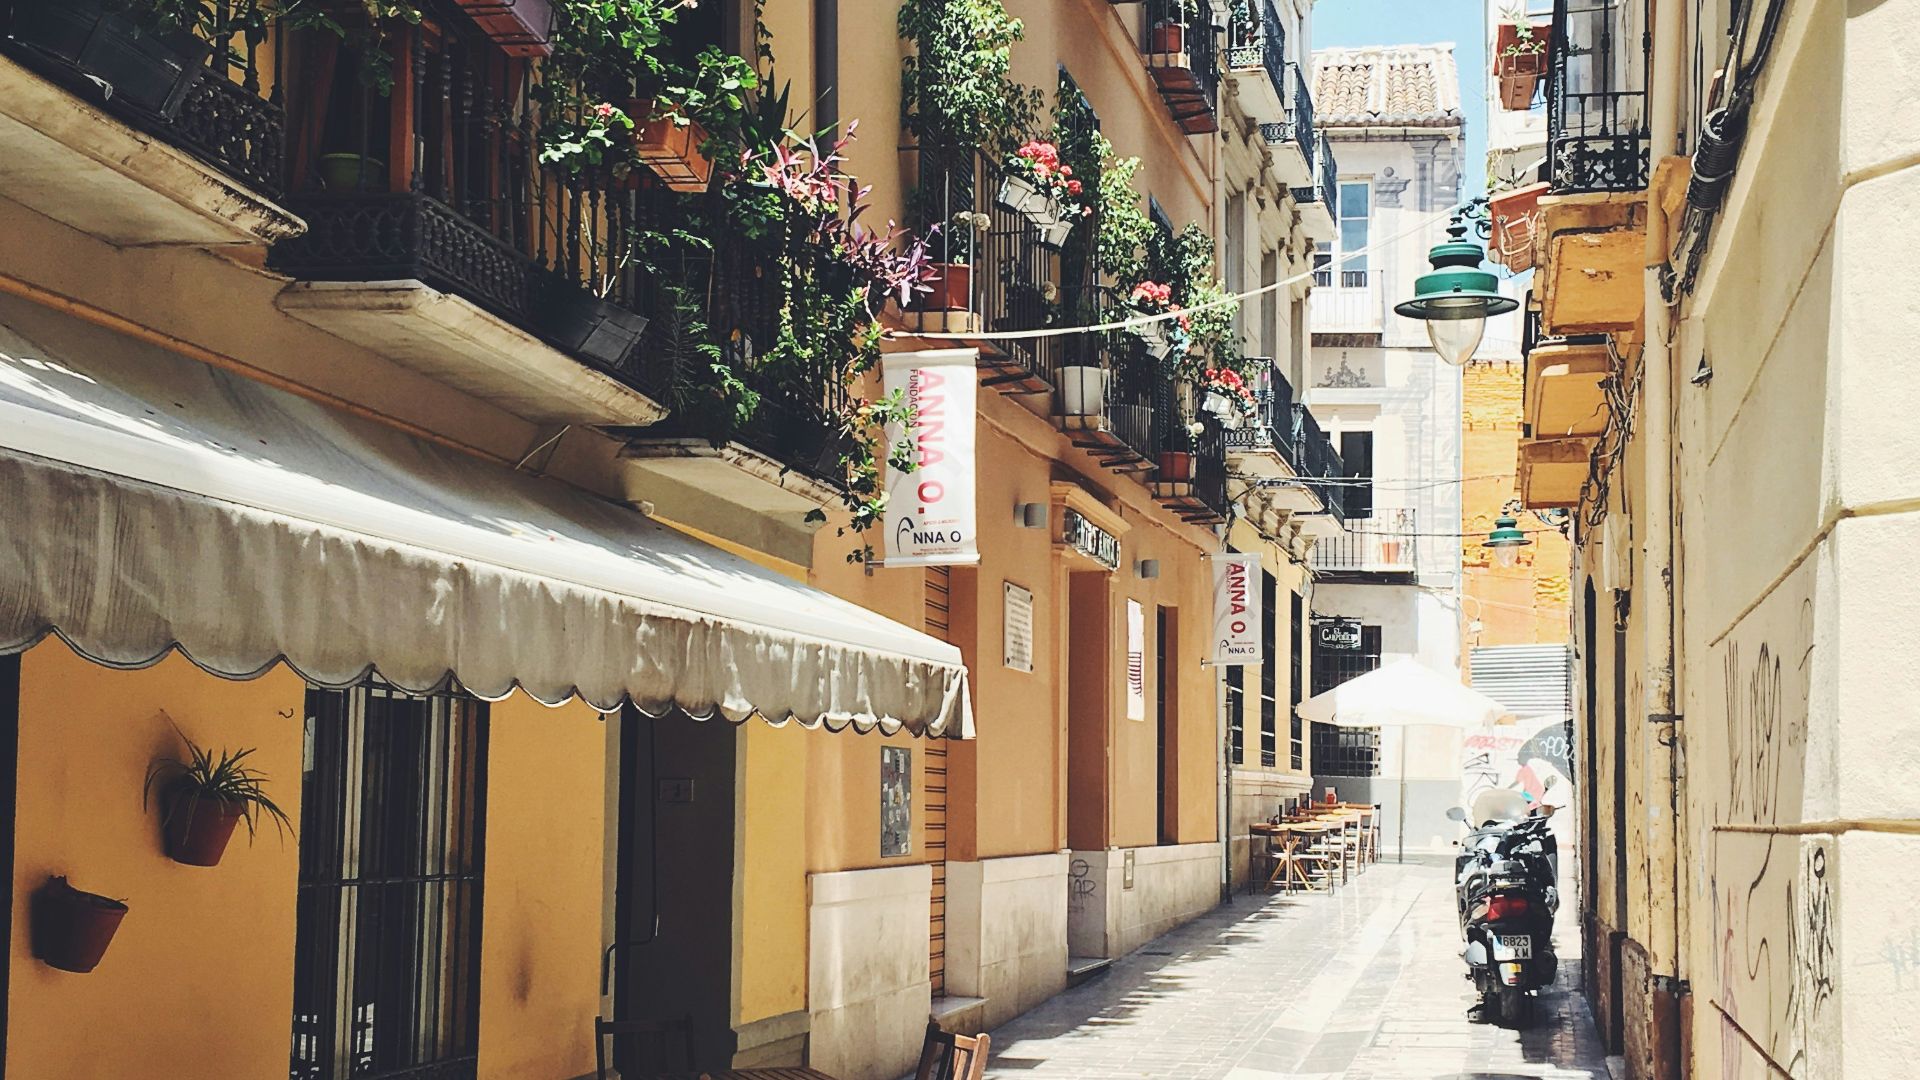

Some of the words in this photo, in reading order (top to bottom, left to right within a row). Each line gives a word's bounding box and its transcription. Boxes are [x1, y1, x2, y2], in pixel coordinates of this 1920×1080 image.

[918, 370, 944, 466] ANNA
[918, 481, 945, 514] O.
[950, 530, 961, 543] O
[1230, 563, 1245, 615] ANNA
[1231, 621, 1246, 638] O.
[1503, 936, 1529, 947] 6823
